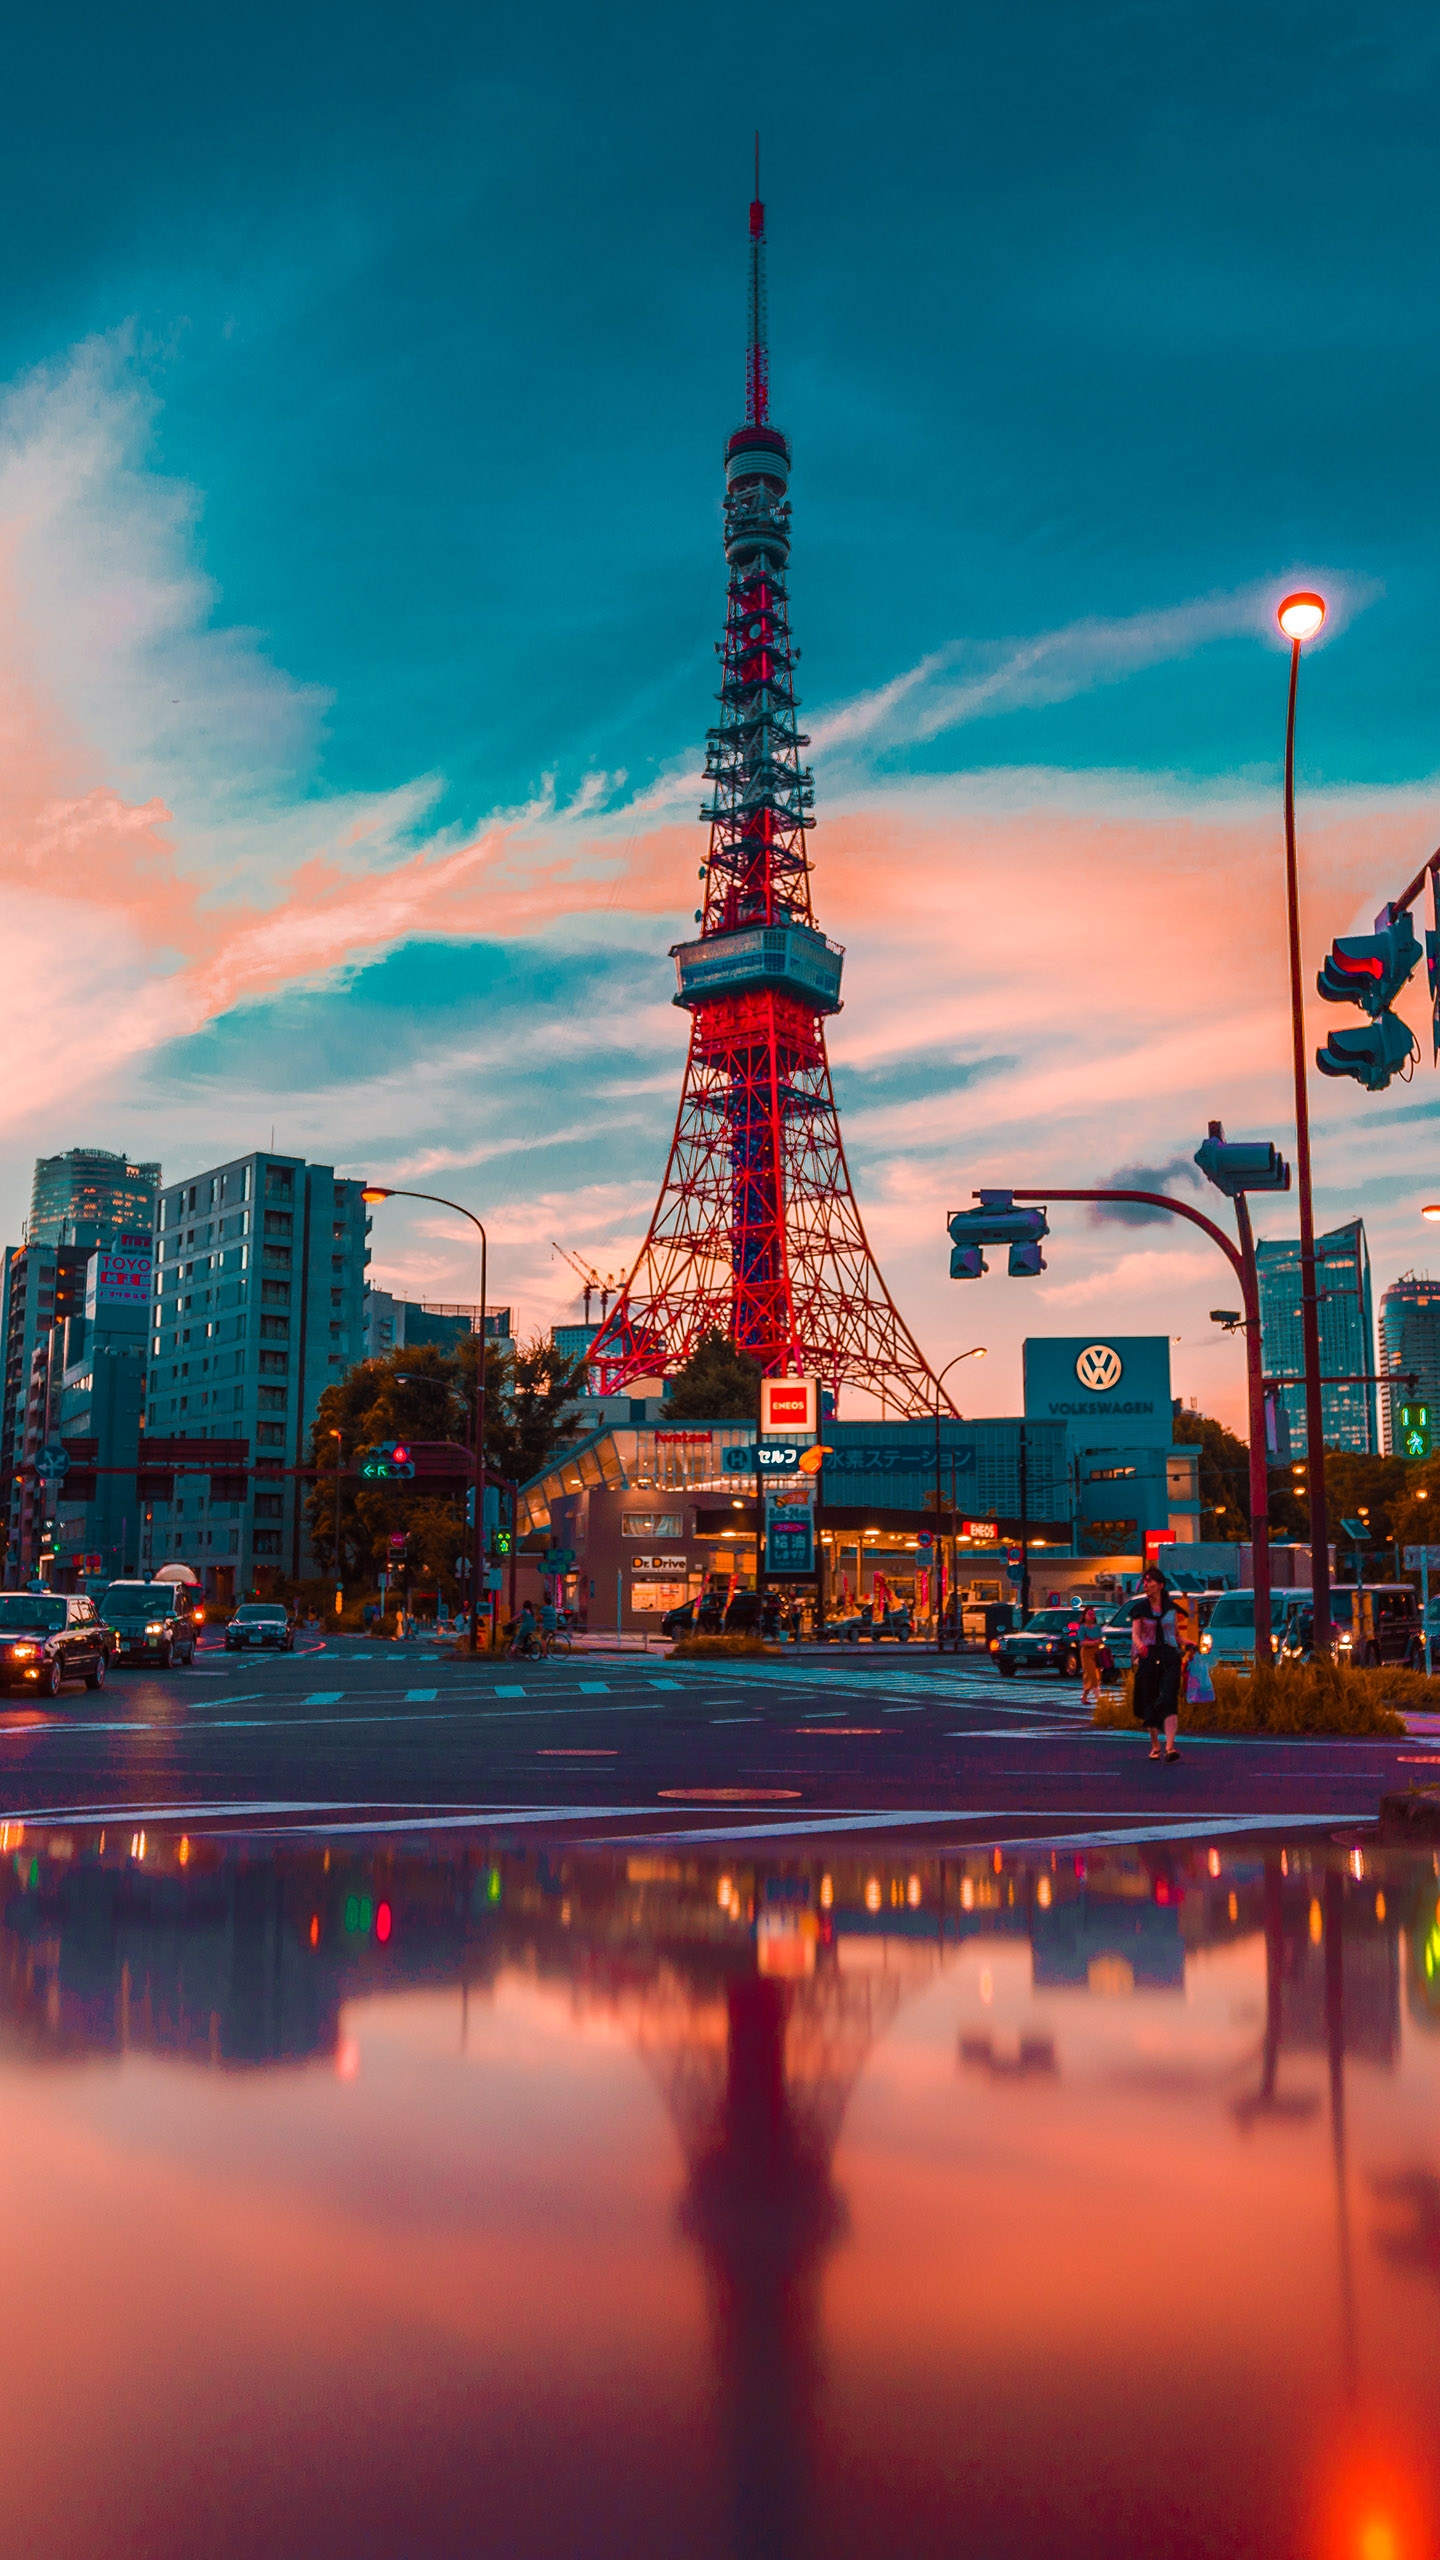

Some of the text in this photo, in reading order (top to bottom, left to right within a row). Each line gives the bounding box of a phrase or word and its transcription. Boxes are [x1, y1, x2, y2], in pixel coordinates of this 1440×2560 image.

[772, 1401, 804, 1411] ENEOS
[1049, 1402, 1154, 1415] VOLKSWAGEN
[758, 1449, 797, 1464] セルフ
[826, 1450, 972, 1469] 水素ステーション
[970, 1523, 994, 1538] ENEOS
[632, 1557, 686, 1568] Dr. Drive
